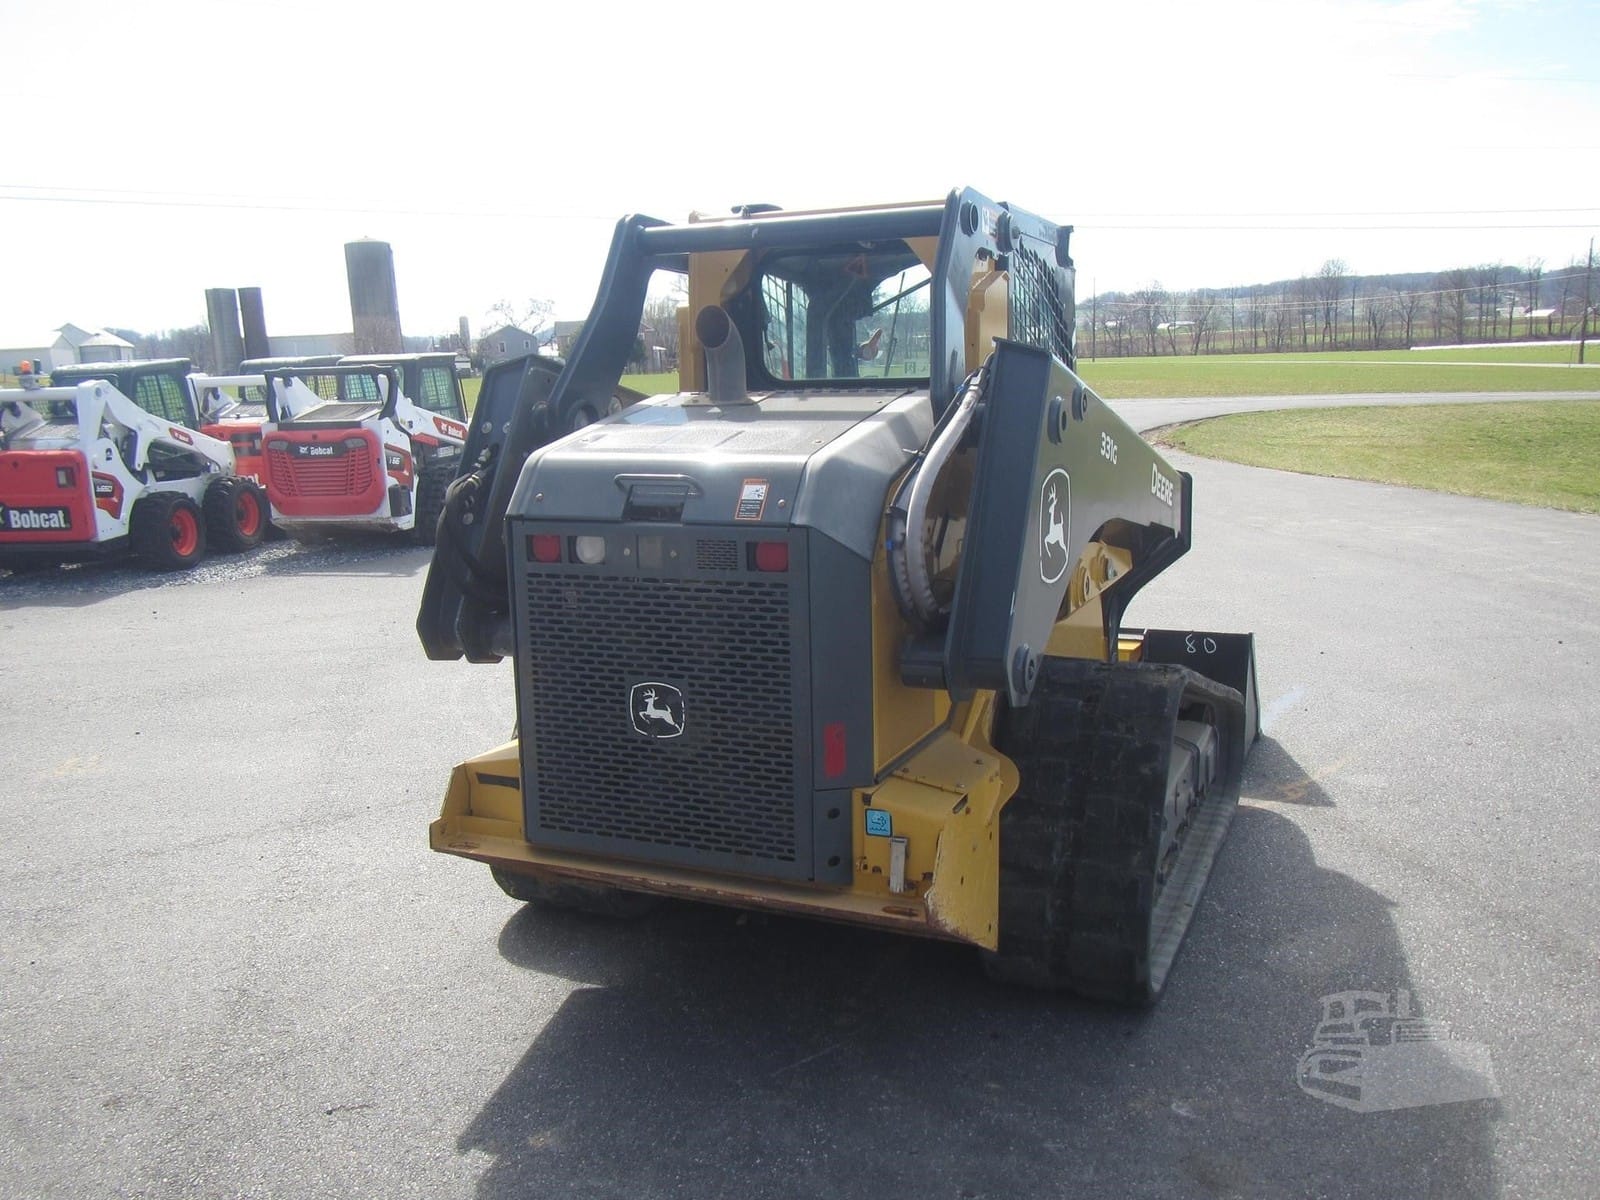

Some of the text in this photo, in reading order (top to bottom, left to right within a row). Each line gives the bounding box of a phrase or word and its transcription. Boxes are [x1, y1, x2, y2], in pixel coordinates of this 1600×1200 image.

[310, 446, 333, 455] Bobcat
[1100, 432, 1118, 464] 331G
[1151, 463, 1174, 507] DEERE
[9, 509, 66, 529] Bobcat
[1185, 633, 1217, 654] 80
